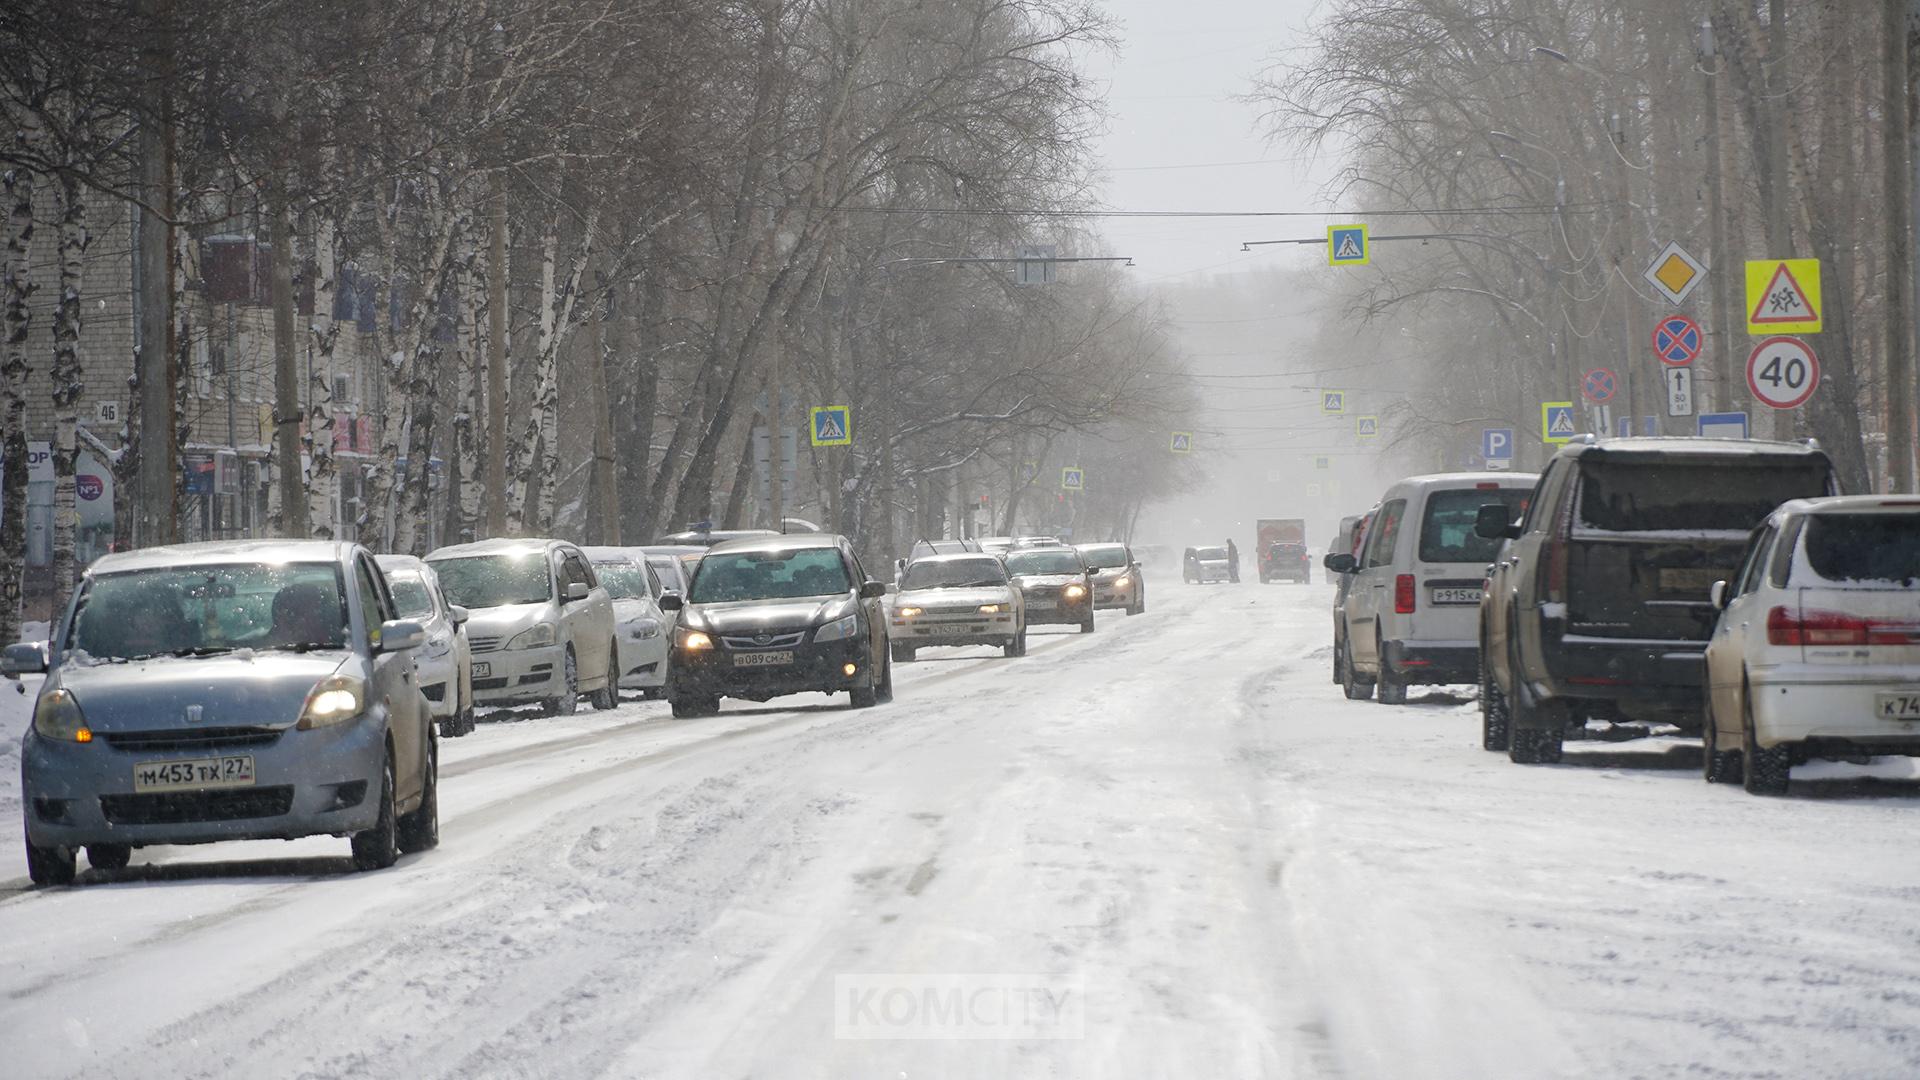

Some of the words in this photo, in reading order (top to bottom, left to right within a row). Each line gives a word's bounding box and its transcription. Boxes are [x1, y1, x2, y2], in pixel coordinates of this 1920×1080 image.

[1759, 356, 1806, 389] 40
[101, 405, 115, 421] 46
[1489, 432, 1506, 456] P
[476, 664, 486, 673] 27
[143, 763, 221, 785] М453ТХ
[225, 758, 244, 774] 27
